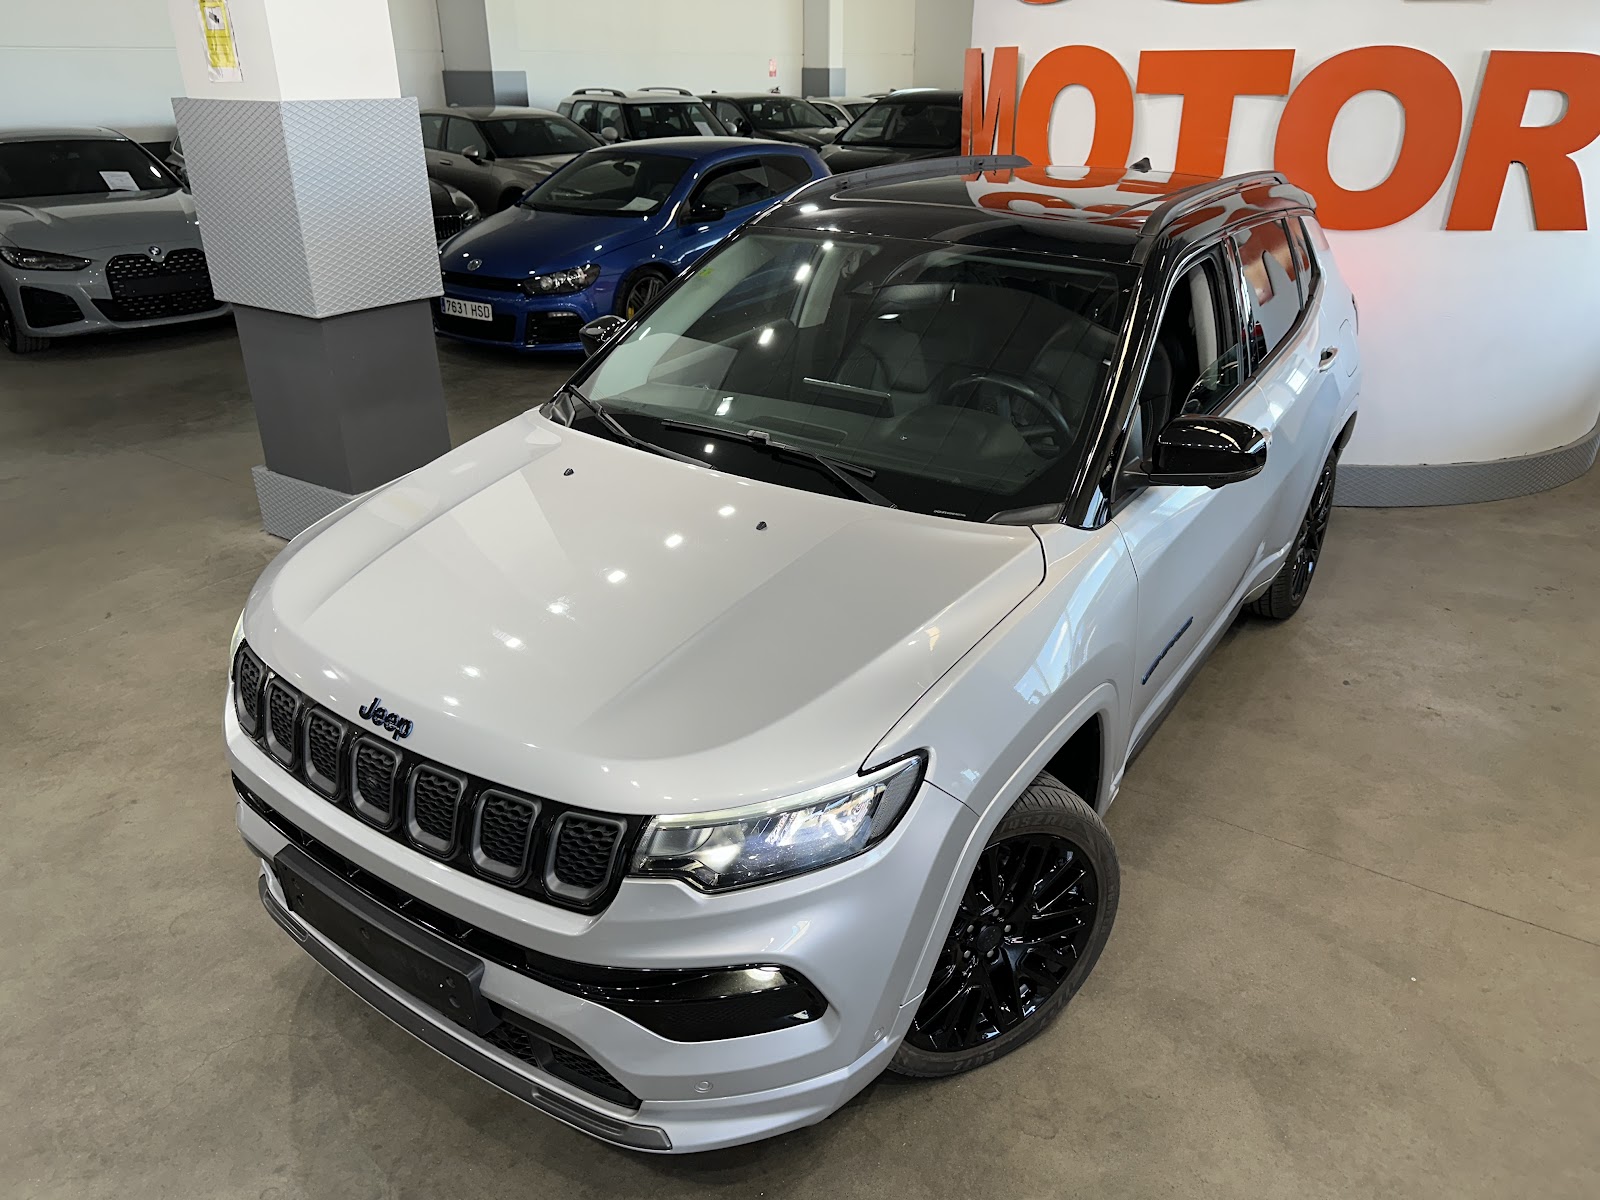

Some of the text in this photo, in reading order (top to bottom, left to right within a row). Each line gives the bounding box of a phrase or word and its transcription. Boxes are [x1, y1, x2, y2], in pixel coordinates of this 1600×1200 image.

[960, 45, 1600, 231] MOTOR
[446, 300, 467, 315] 7631
[358, 696, 414, 741] Jeep
